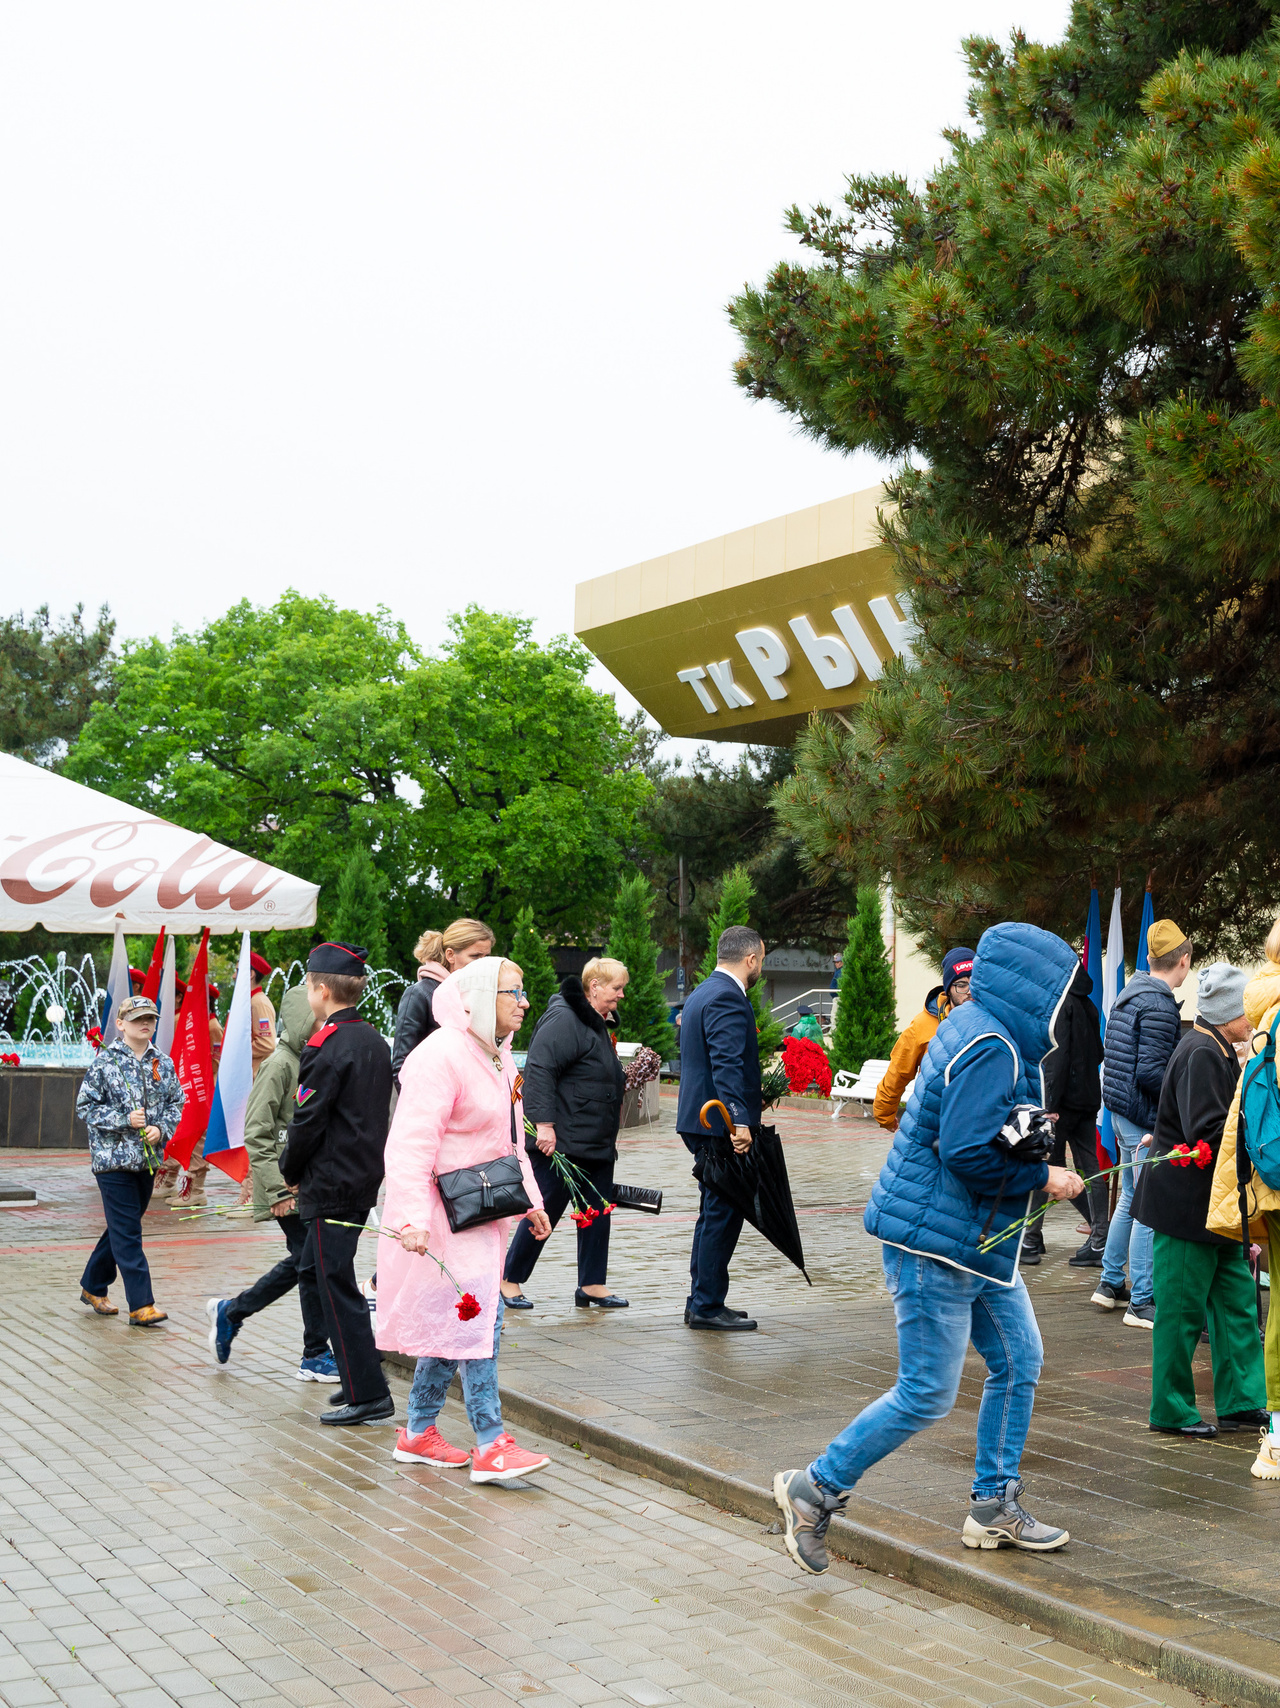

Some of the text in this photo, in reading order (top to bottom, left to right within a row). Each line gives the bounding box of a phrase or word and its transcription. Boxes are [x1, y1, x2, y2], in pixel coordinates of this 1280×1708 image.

[676, 659, 755, 714] ТК
[678, 968, 685, 980] P
[190, 1063, 207, 1103] ОРДЕНА
